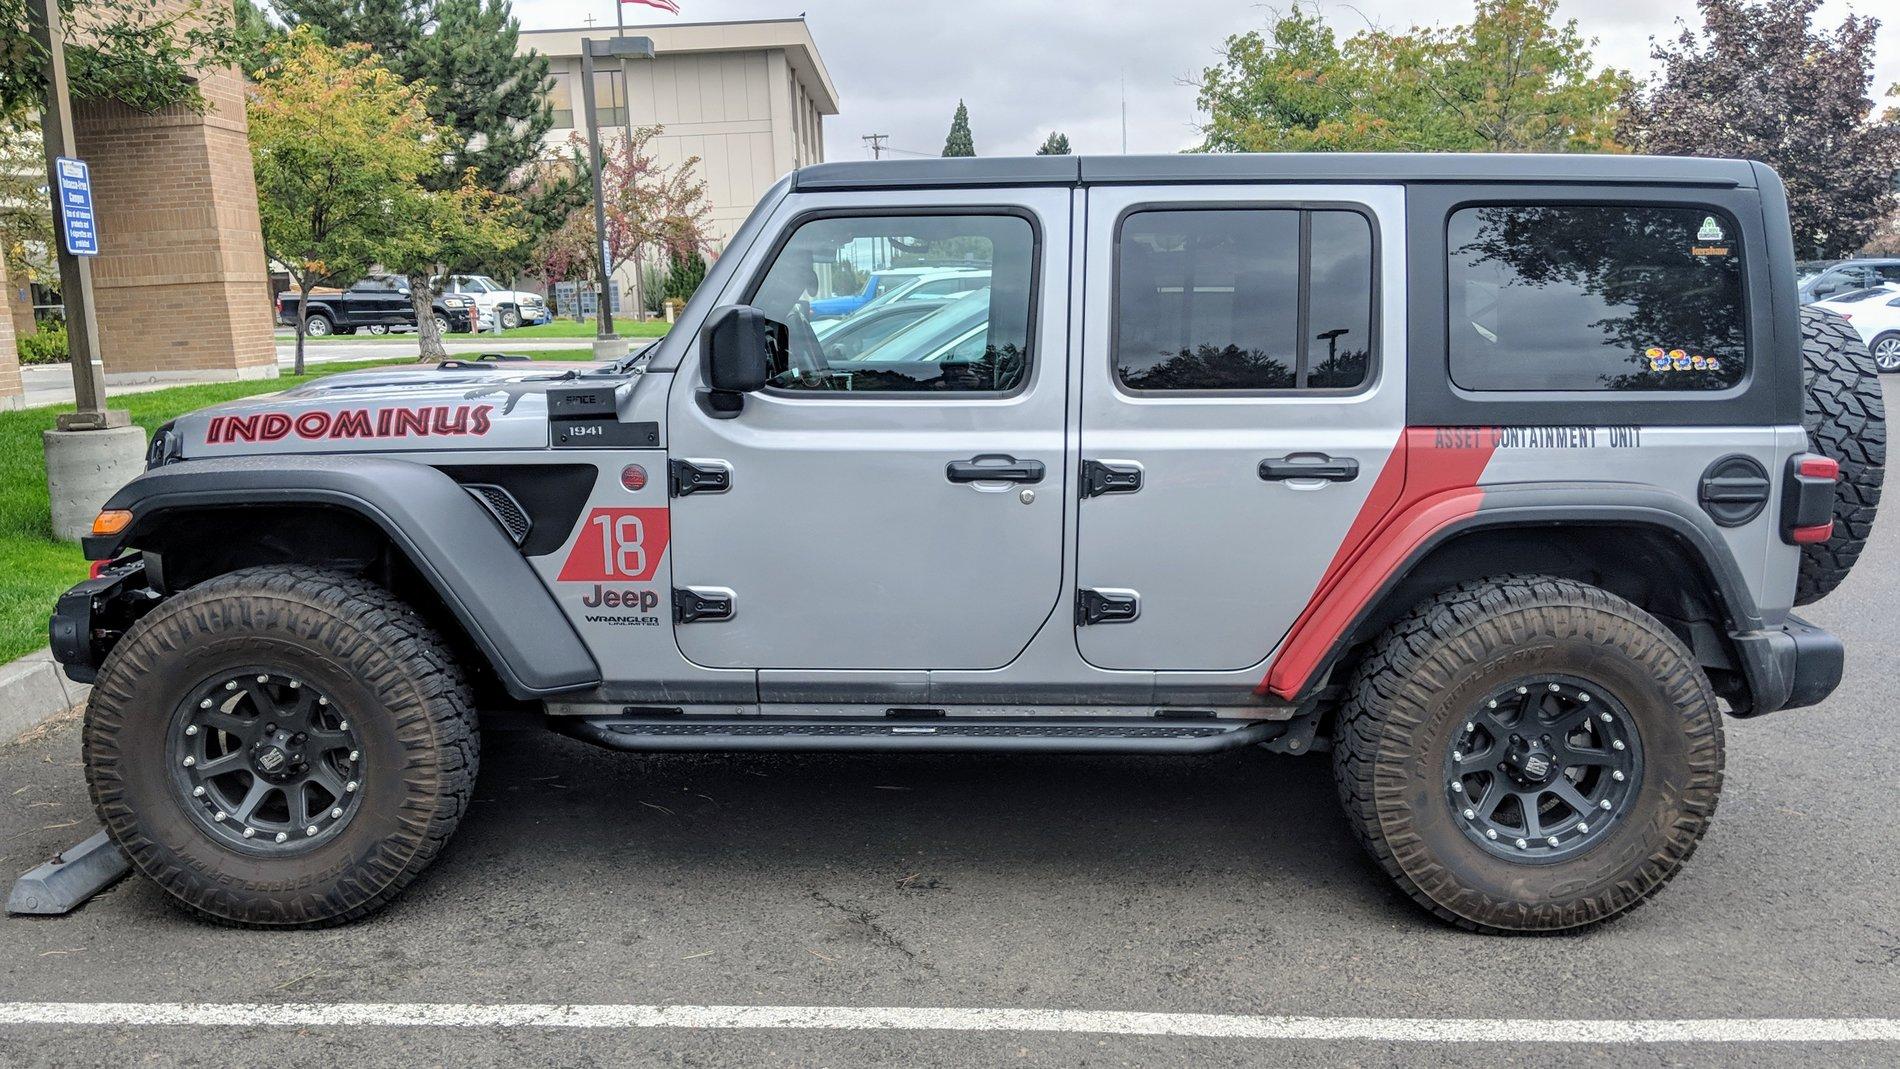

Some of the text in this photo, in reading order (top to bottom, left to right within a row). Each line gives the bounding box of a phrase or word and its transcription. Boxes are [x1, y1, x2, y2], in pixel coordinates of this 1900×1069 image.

[205, 404, 494, 444] INDOMINUS
[569, 425, 603, 436] 1941
[1434, 426, 1642, 449] ASSET CONTAINMENT UNIT
[593, 514, 647, 577] 18
[582, 584, 659, 613] Jeep
[584, 615, 659, 623] WRANGLER
